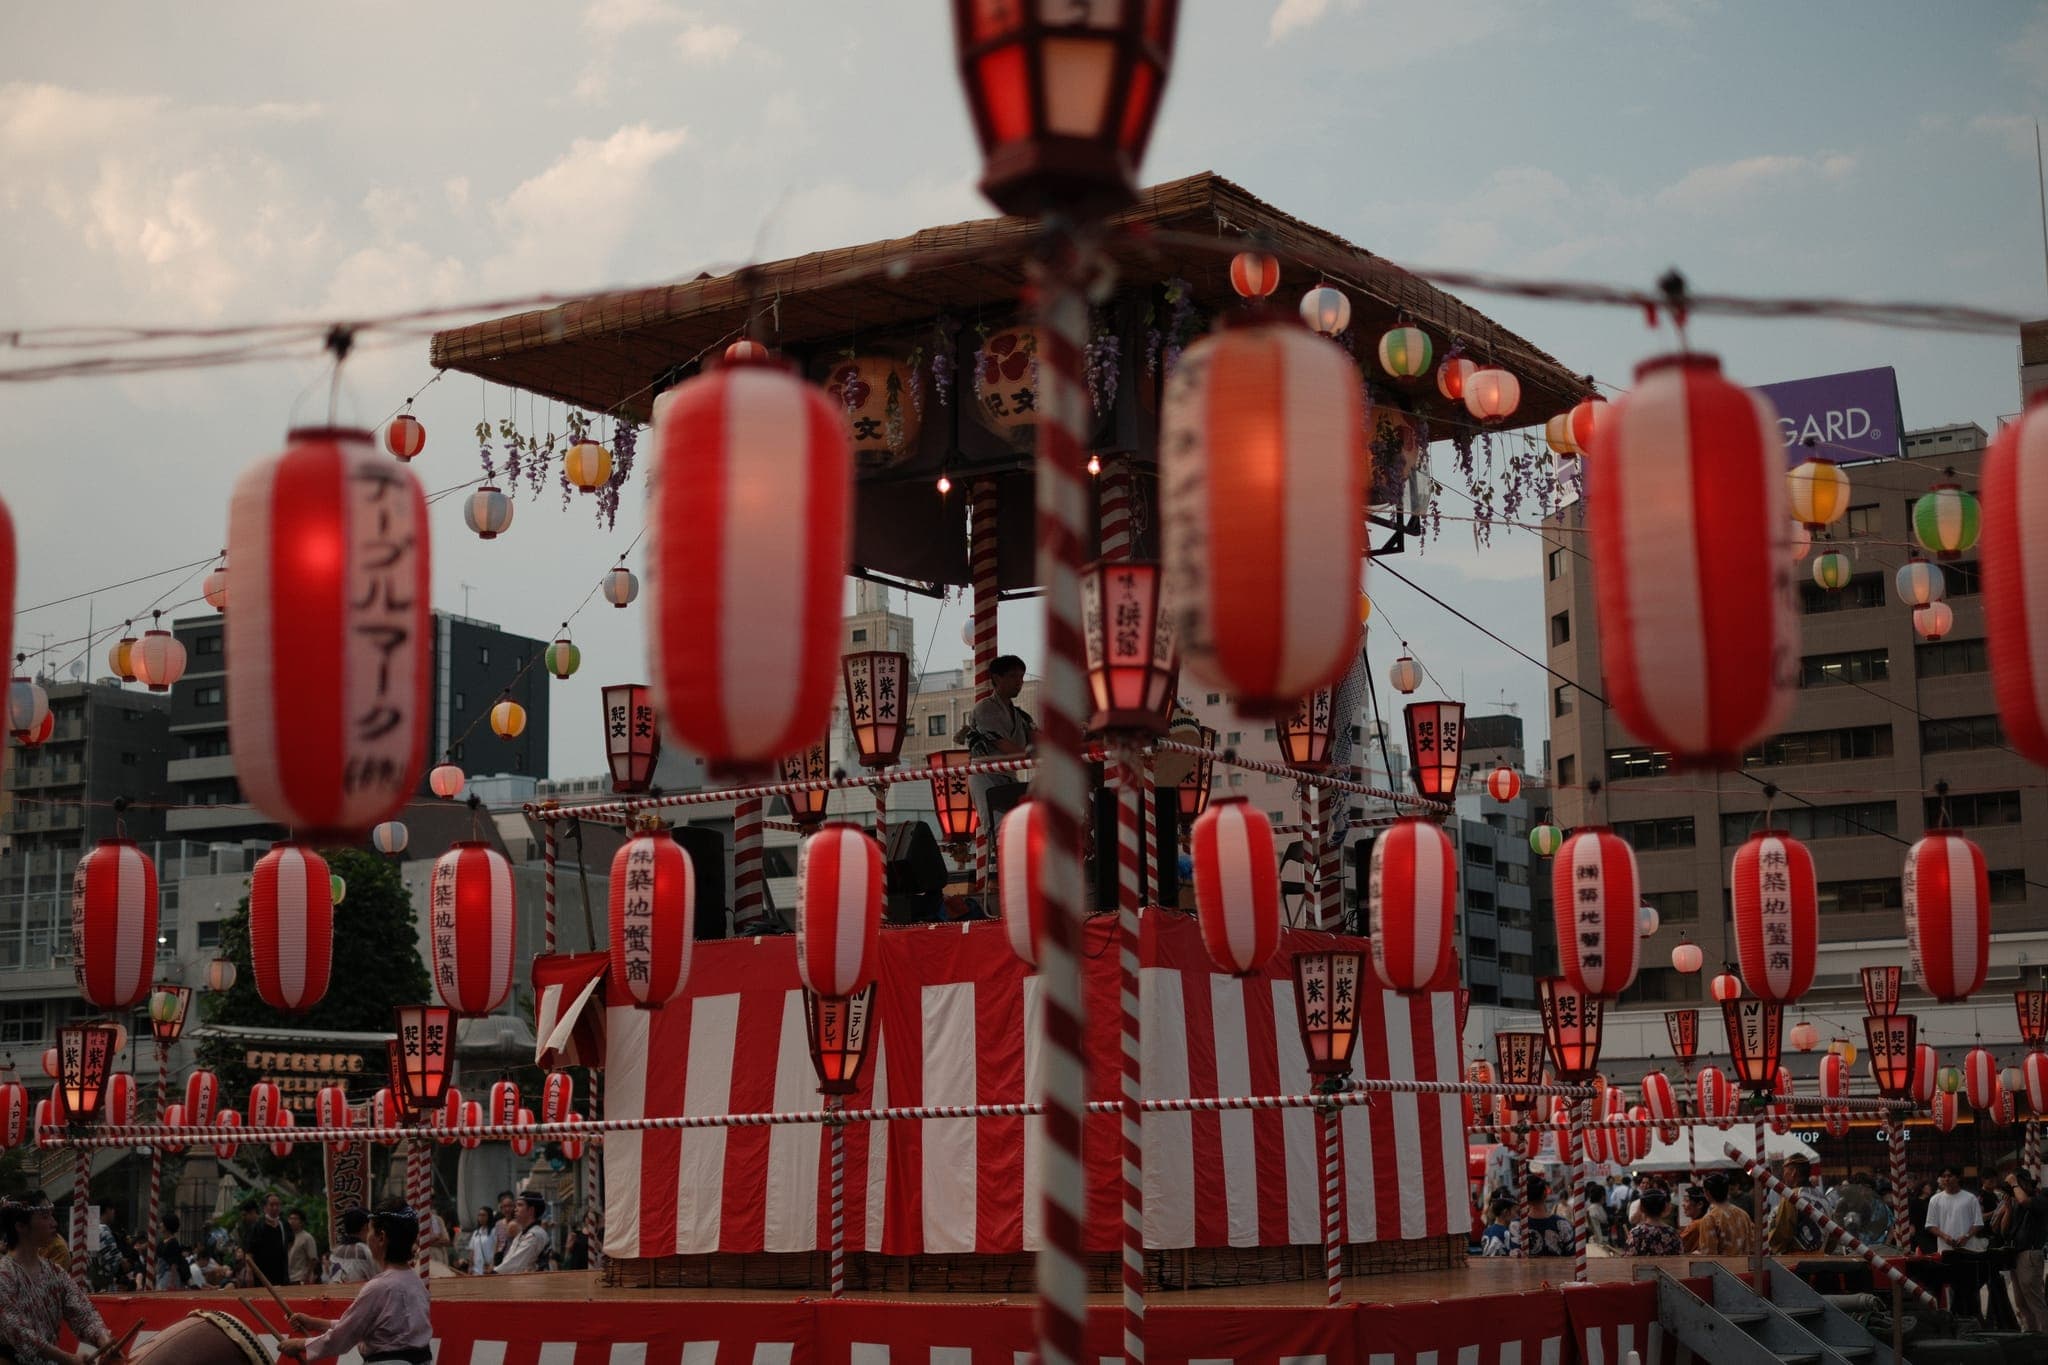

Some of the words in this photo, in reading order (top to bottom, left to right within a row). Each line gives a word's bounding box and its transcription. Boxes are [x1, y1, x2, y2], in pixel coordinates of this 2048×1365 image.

[854, 678, 871, 721] 紫水
[879, 676, 896, 719] 紫水
[611, 706, 626, 738] 紀文
[635, 705, 652, 738] 紀文
[1418, 722, 1434, 752] 紀文
[1443, 722, 1457, 752] 紀文
[1307, 978, 1327, 1028] 紫水
[1334, 977, 1353, 1025] 紫水
[1559, 996, 1578, 1028] 紀文
[404, 1025, 419, 1056] 紀文
[427, 1025, 443, 1056] 紀文
[825, 1005, 836, 1047] ニチレイ
[850, 1005, 862, 1047] ニチレイ
[1746, 1019, 1758, 1055] ニチレイ
[1891, 1030, 1905, 1056] 紀文
[1873, 1031, 1886, 1056] 紀文
[65, 1047, 80, 1087] 紫水
[86, 1047, 103, 1087] 紫水
[1513, 1048, 1527, 1078] 紫水
[258, 1095, 267, 1127] APE
[323, 1100, 331, 1124] APE
[504, 1086, 515, 1124] APE
[549, 1079, 561, 1120] APEX
[10, 1100, 21, 1139] APEX
